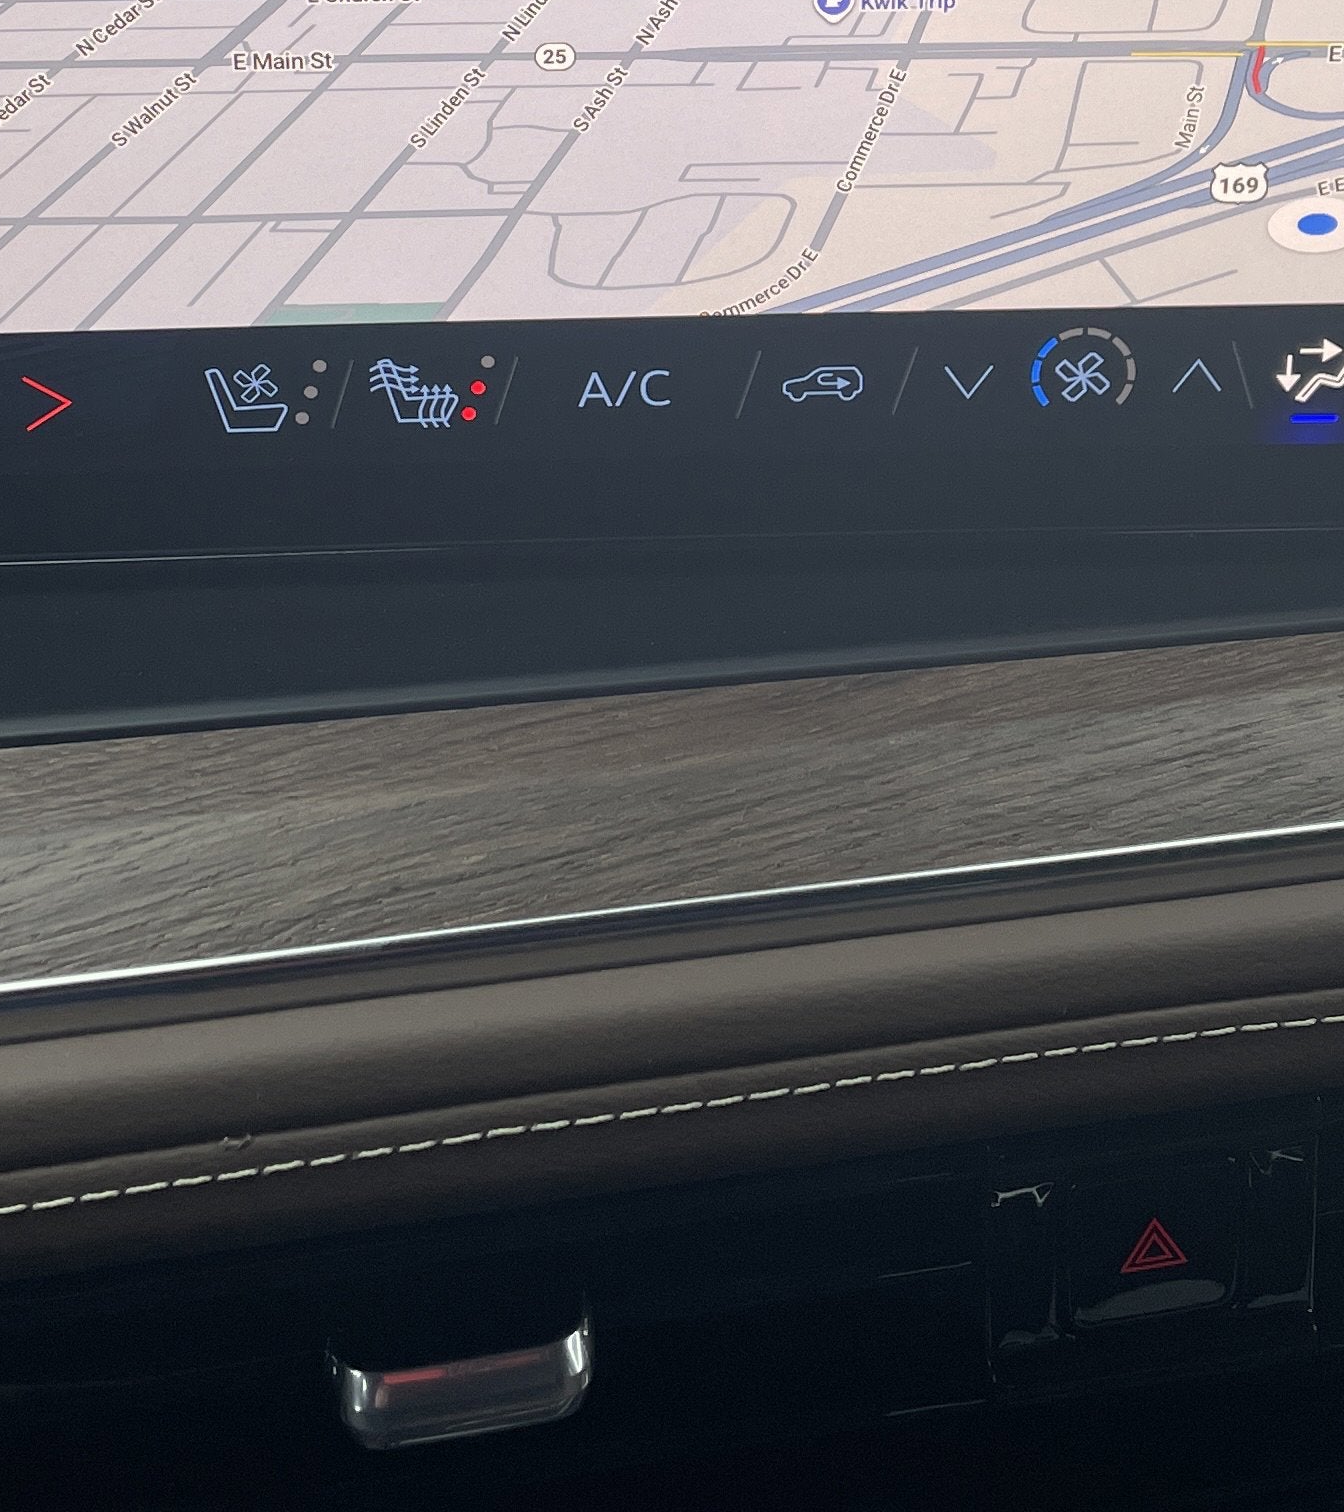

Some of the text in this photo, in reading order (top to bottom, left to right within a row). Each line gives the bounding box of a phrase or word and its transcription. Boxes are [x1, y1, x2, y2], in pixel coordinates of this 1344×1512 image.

[75, 40, 95, 57] N
[93, 5, 141, 45] Cedar
[233, 52, 333, 70] E Main St
[542, 49, 567, 64] 25
[1328, 46, 1342, 62] E
[28, 73, 52, 95] St
[573, 67, 629, 133] S Ash St
[111, 72, 197, 148] S Walnut St
[410, 67, 487, 150] S Linden St
[1174, 85, 1205, 150] Main St
[836, 67, 907, 193] Commerce Dr E
[1219, 177, 1260, 195] 169
[1317, 181, 1330, 196] E
[579, 370, 672, 408] A/C
